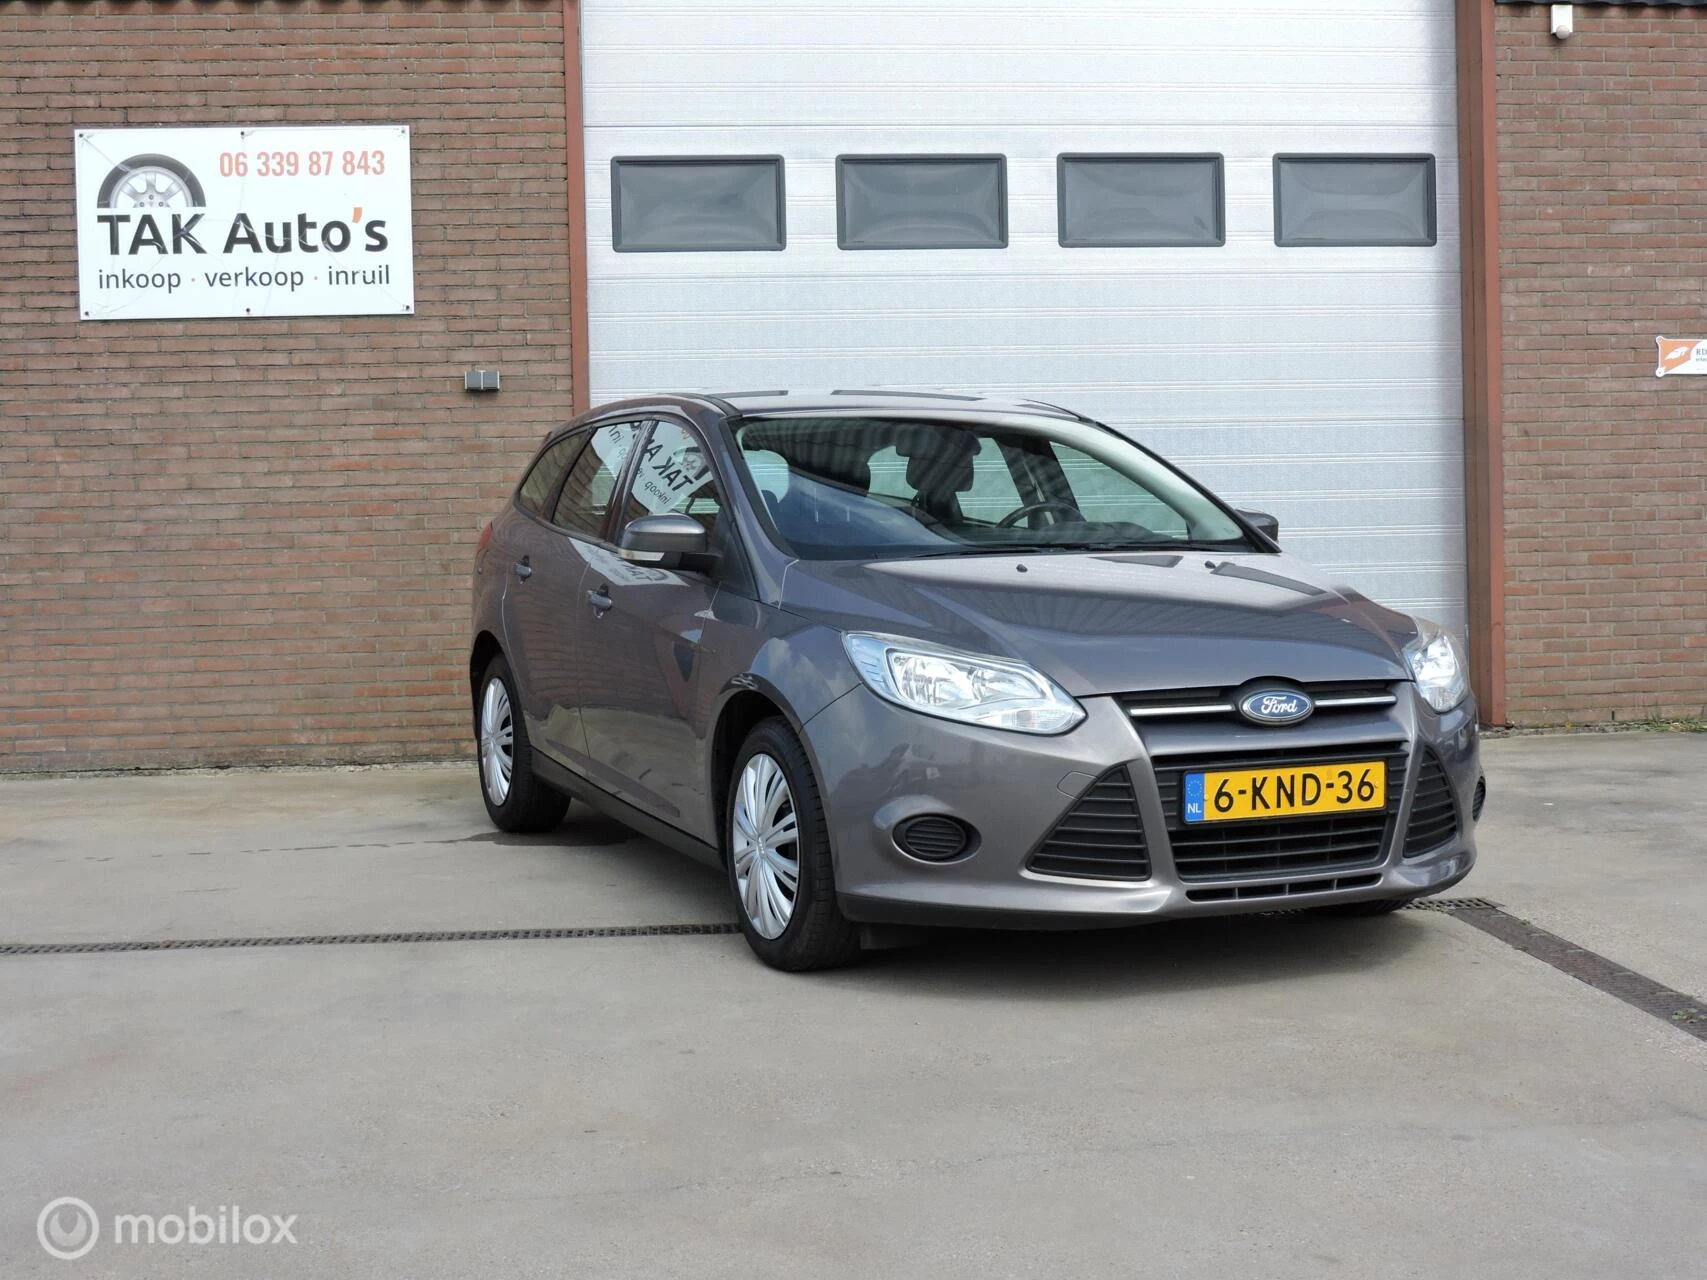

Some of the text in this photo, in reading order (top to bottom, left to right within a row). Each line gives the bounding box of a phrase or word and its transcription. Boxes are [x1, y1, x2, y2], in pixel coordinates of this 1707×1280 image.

[219, 150, 385, 177] 06 339 87 843
[97, 207, 388, 255] TAK Auto's
[98, 265, 390, 293] inkoop verkoop inruil
[1261, 696, 1298, 714] Ford
[1213, 769, 1375, 813] 6-KND-36
[1187, 802, 1202, 813] NL
